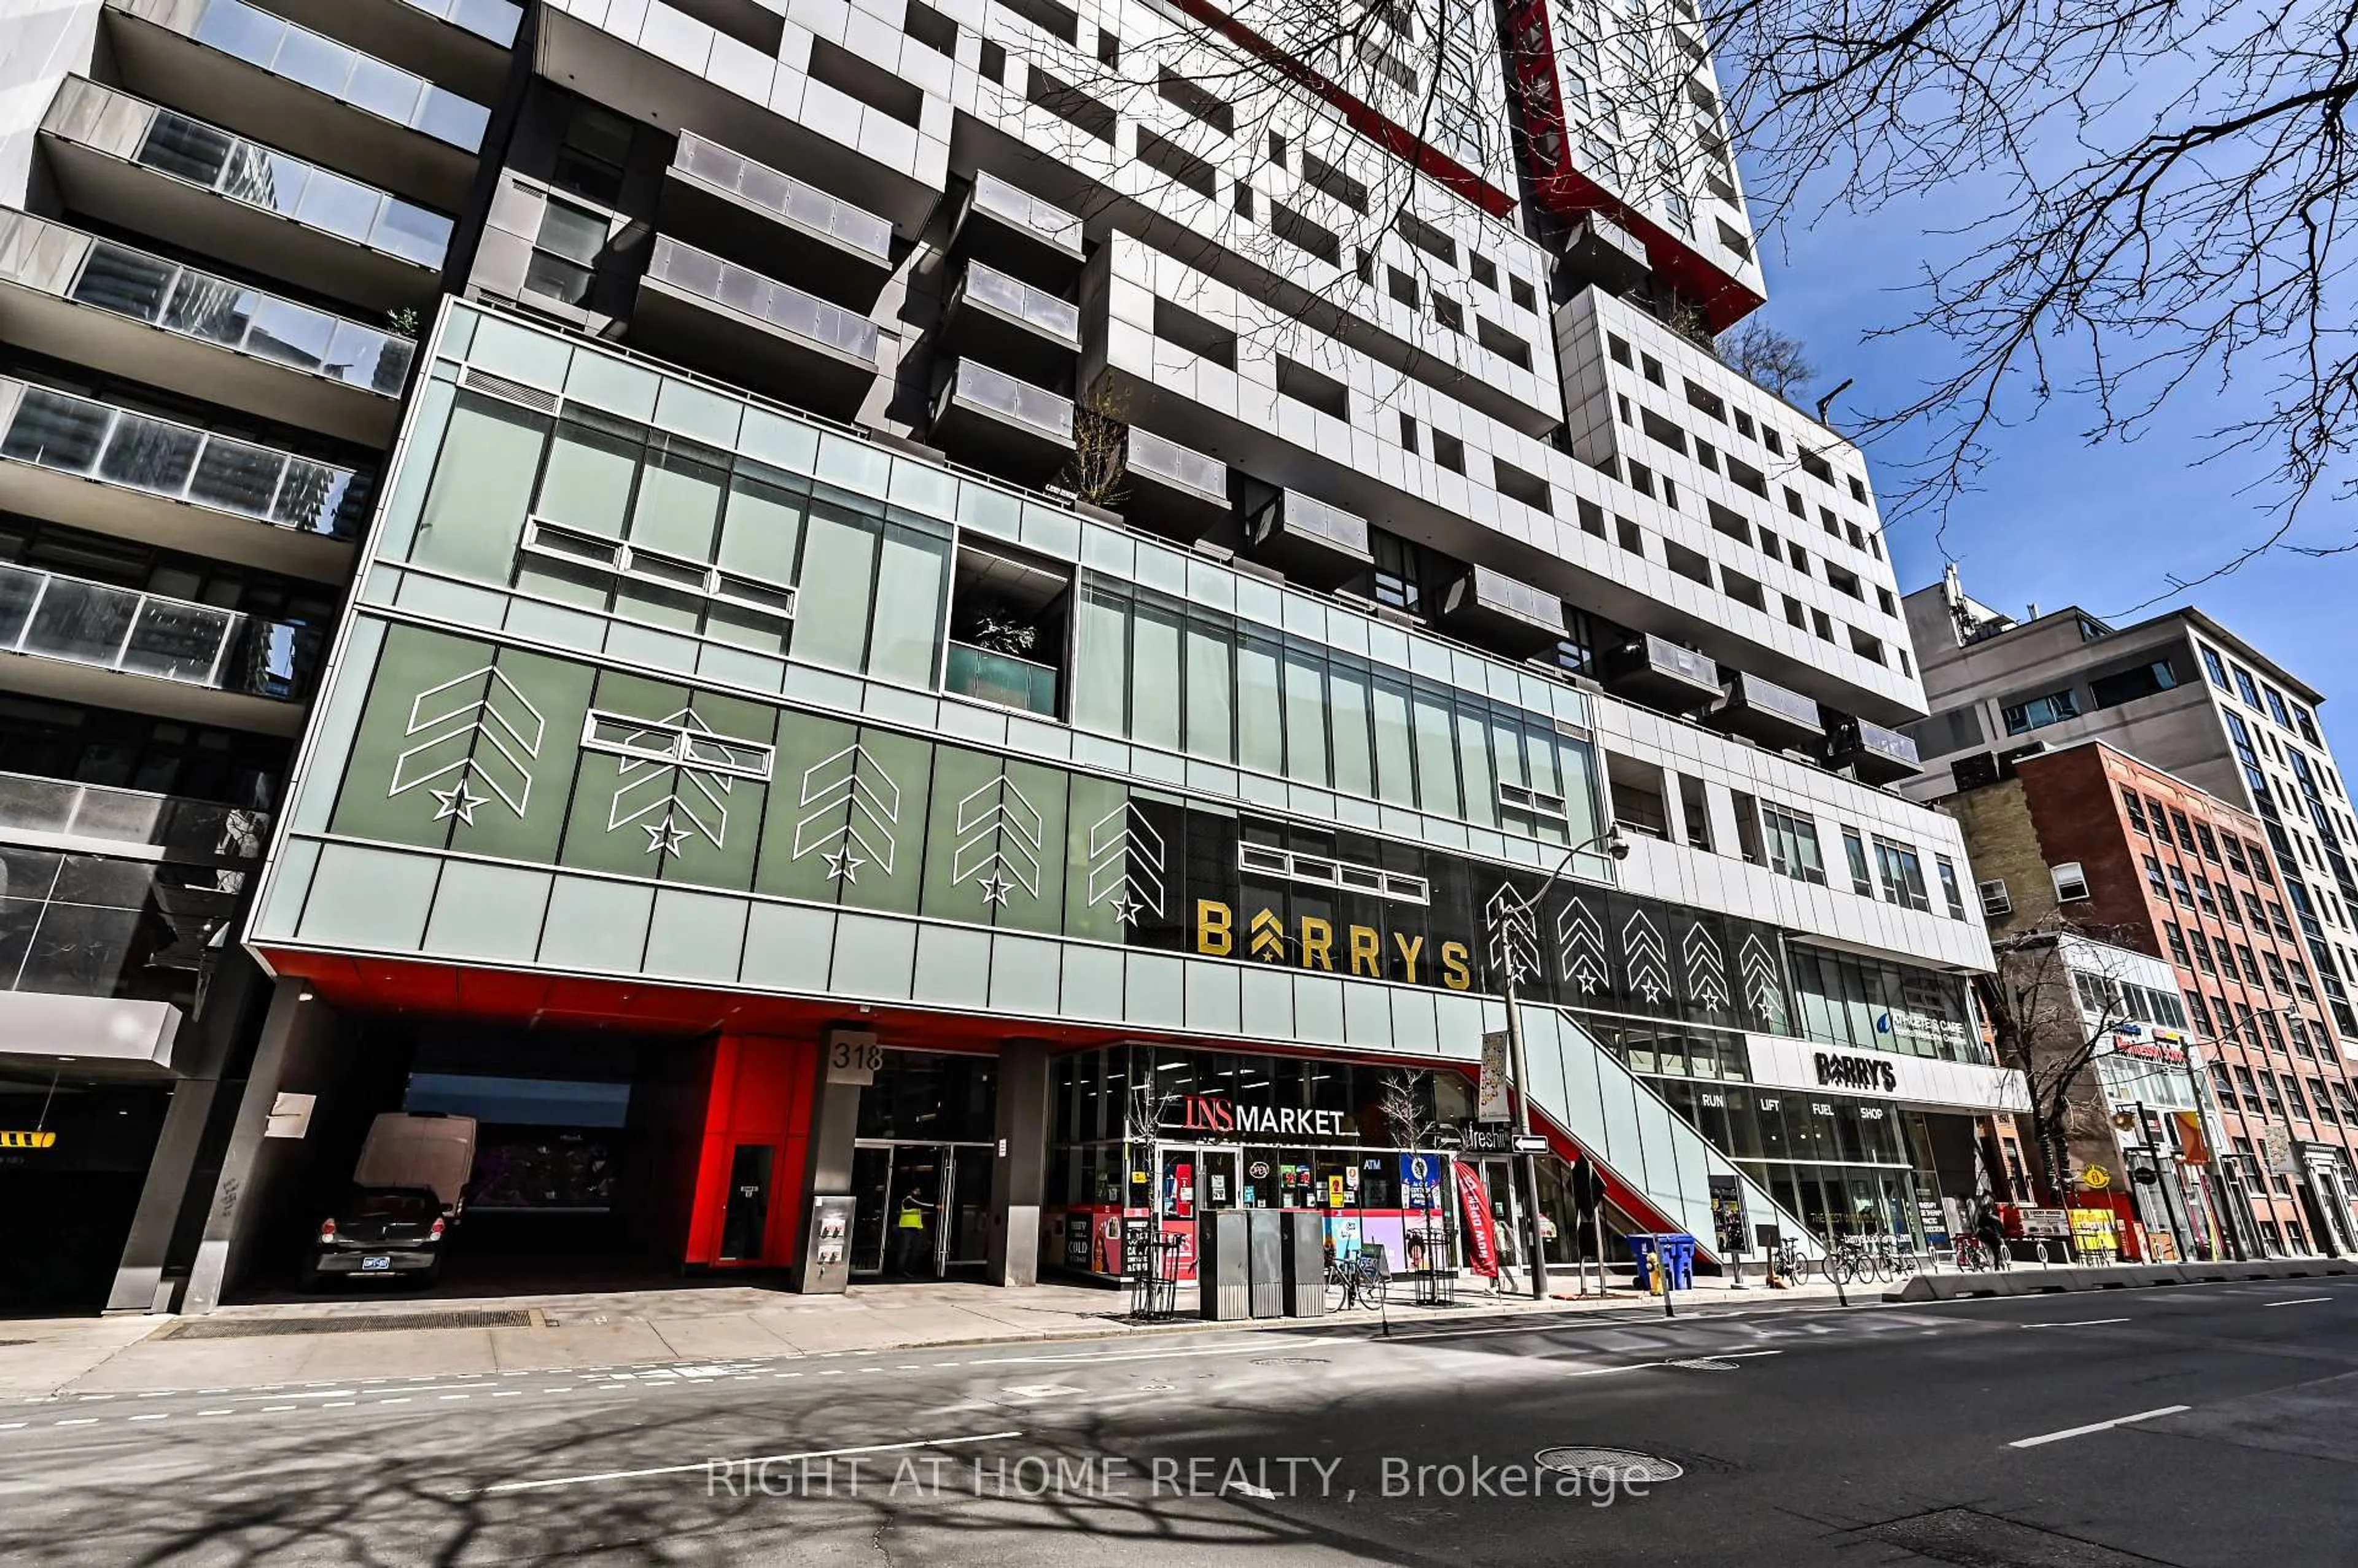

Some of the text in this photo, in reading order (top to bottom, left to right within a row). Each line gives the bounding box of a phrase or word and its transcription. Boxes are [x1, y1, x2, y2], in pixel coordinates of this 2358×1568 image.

[1940, 1020, 1964, 1033] CARE
[833, 1042, 883, 1070] 318
[1814, 1052, 1897, 1091] BARRY'S
[1702, 1093, 1724, 1108] RUN
[1760, 1098, 1780, 1112] LIFT
[1184, 1095, 1345, 1136] INS MARKET
[1812, 1103, 1835, 1116] FUEL
[1860, 1107, 1883, 1120] SHOP
[1363, 1159, 1382, 1170] ATM
[1468, 1195, 1482, 1227] OPEN
[1476, 1230, 1489, 1259] NOW
